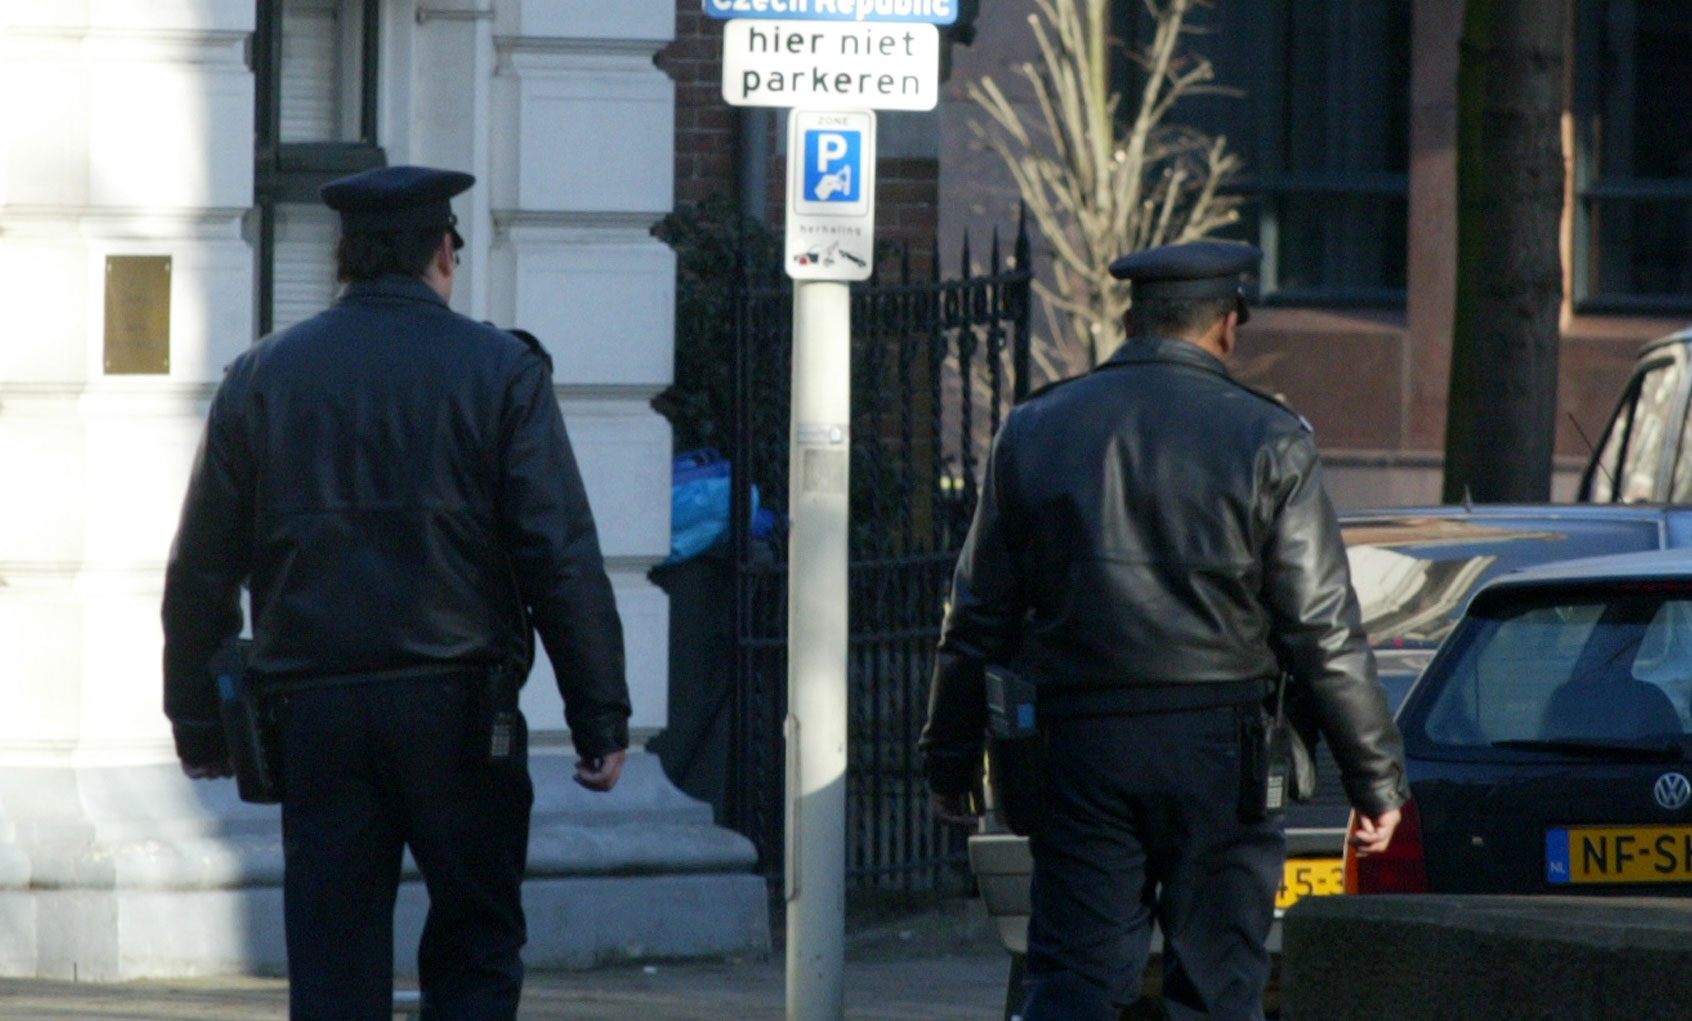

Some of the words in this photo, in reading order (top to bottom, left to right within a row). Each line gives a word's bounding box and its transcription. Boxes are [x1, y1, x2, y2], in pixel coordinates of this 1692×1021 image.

[749, 26, 824, 54] hier
[841, 29, 915, 56] niet
[743, 67, 919, 98] parkeren
[818, 116, 849, 126] ZONE
[817, 133, 848, 173] P
[800, 224, 862, 237] herhaling
[1550, 862, 1566, 874] NL
